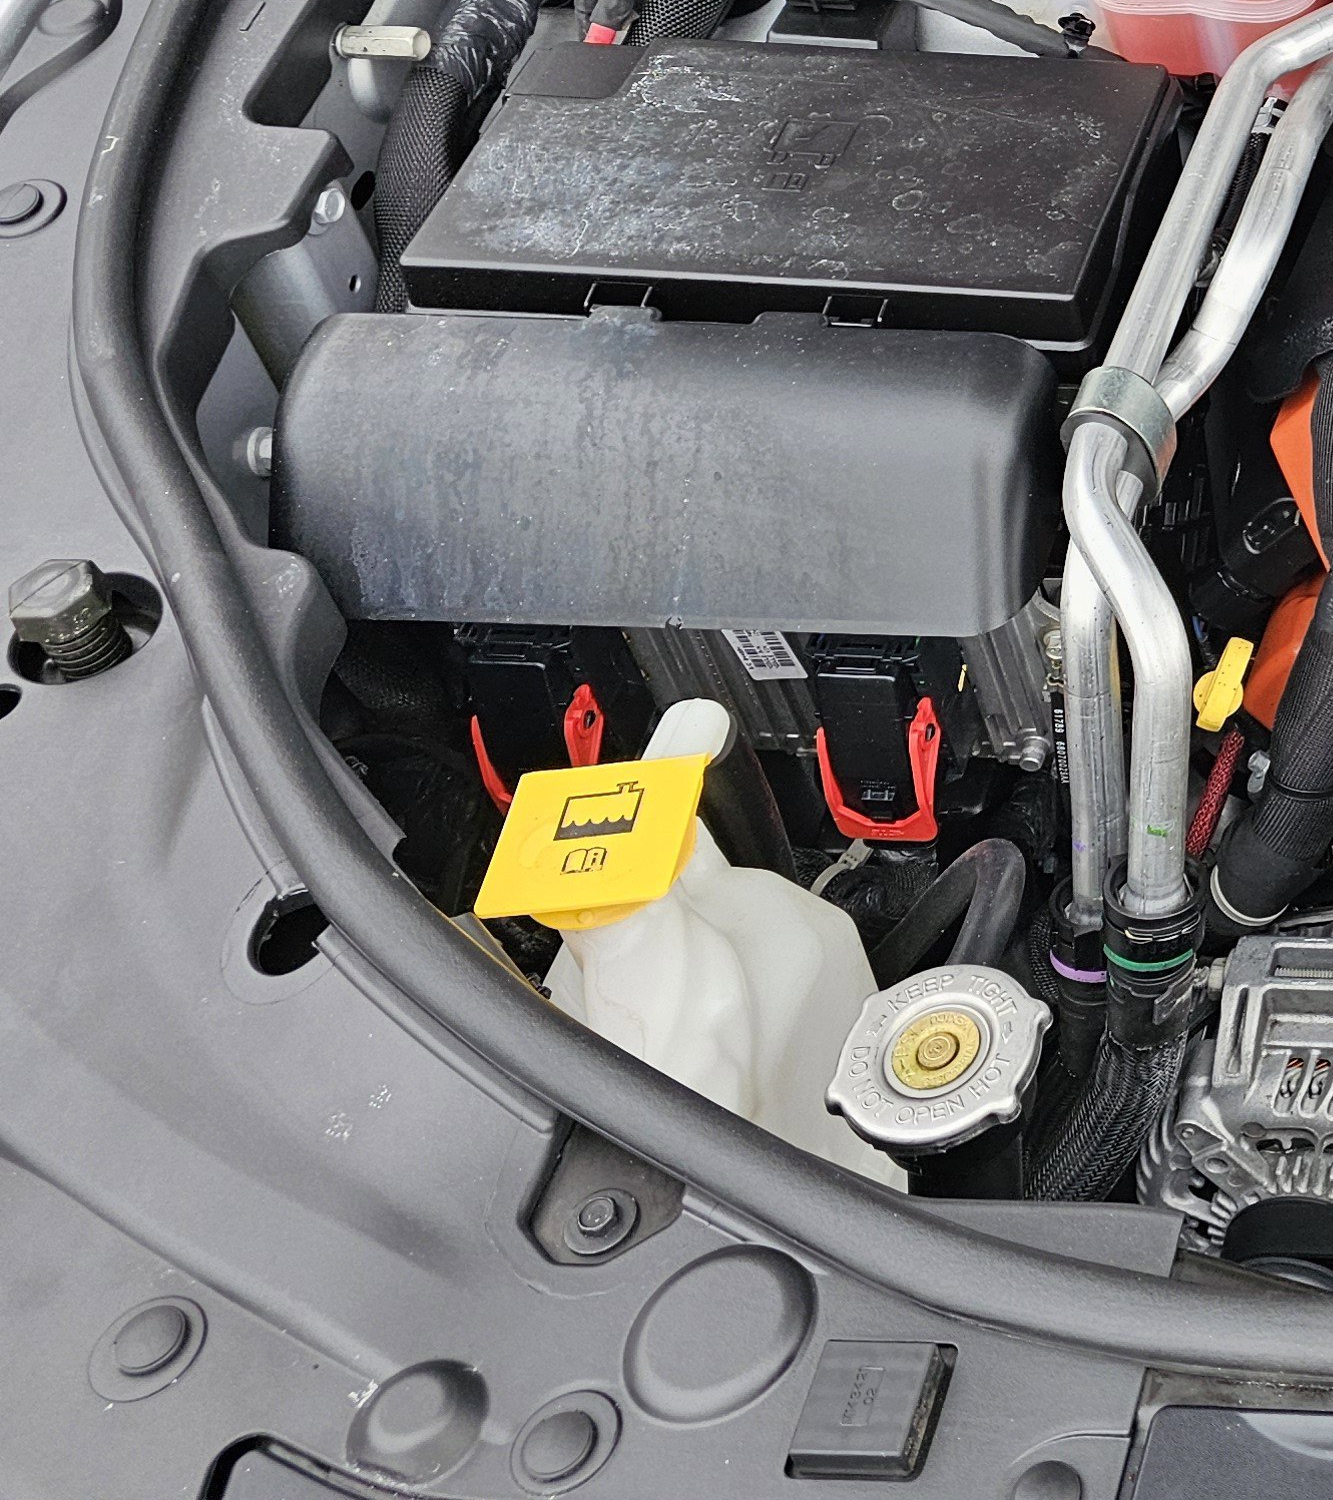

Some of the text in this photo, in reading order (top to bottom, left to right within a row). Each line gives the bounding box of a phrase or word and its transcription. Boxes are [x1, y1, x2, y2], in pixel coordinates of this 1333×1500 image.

[887, 973, 1018, 1016] KEEP TIGHT
[849, 1045, 872, 1078] DO
[968, 1052, 1012, 1100] HOT
[853, 1078, 894, 1118] NOT
[894, 1094, 966, 1126] OPEN
